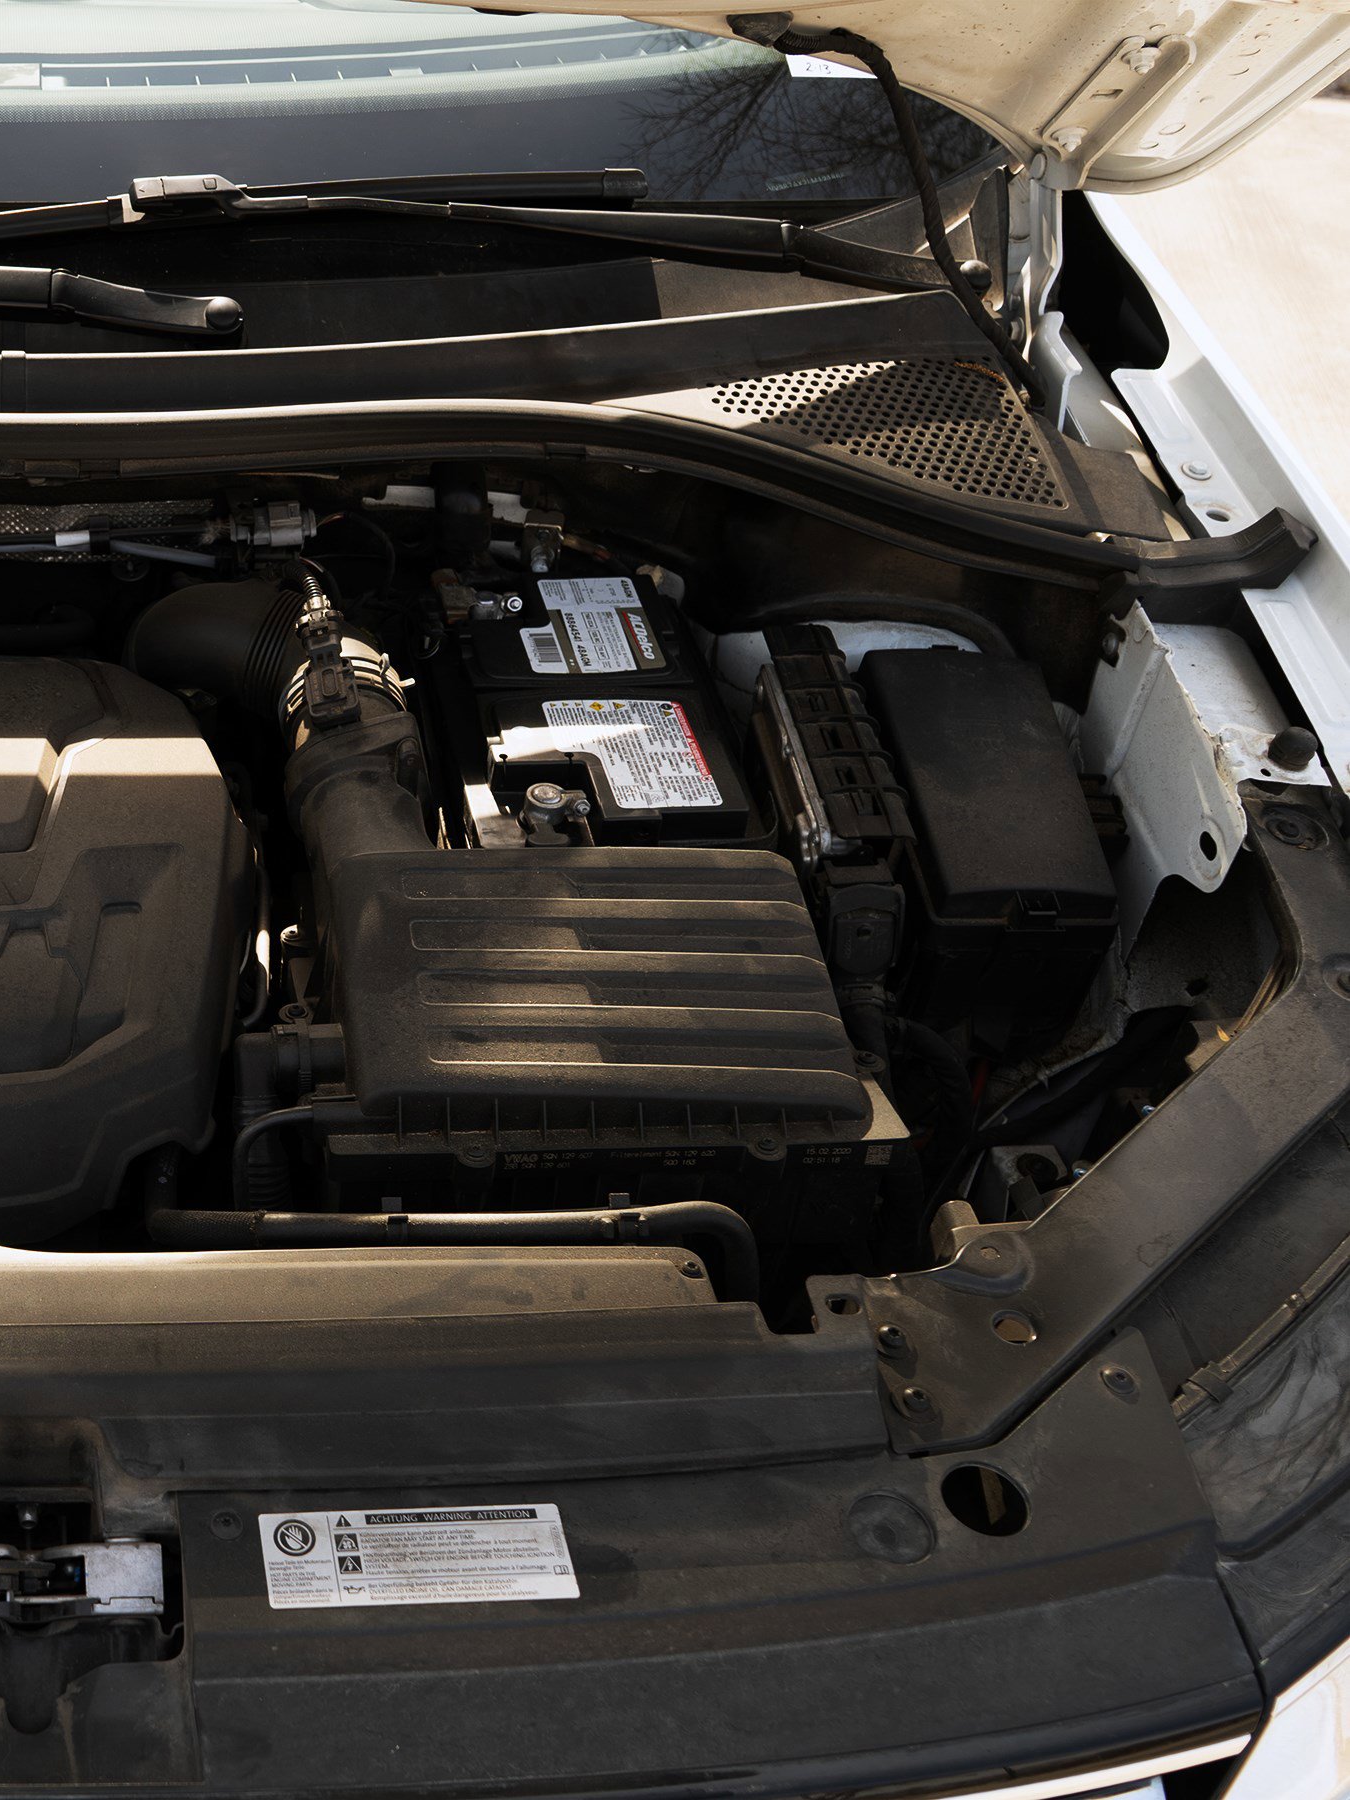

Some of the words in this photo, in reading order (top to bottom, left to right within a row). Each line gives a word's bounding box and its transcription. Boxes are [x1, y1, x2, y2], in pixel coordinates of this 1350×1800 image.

[628, 613, 655, 659] ACDelco
[368, 1513, 417, 1523] ACHTUNG
[422, 1511, 471, 1521] WARNING
[476, 1509, 530, 1519] ATTENTION
